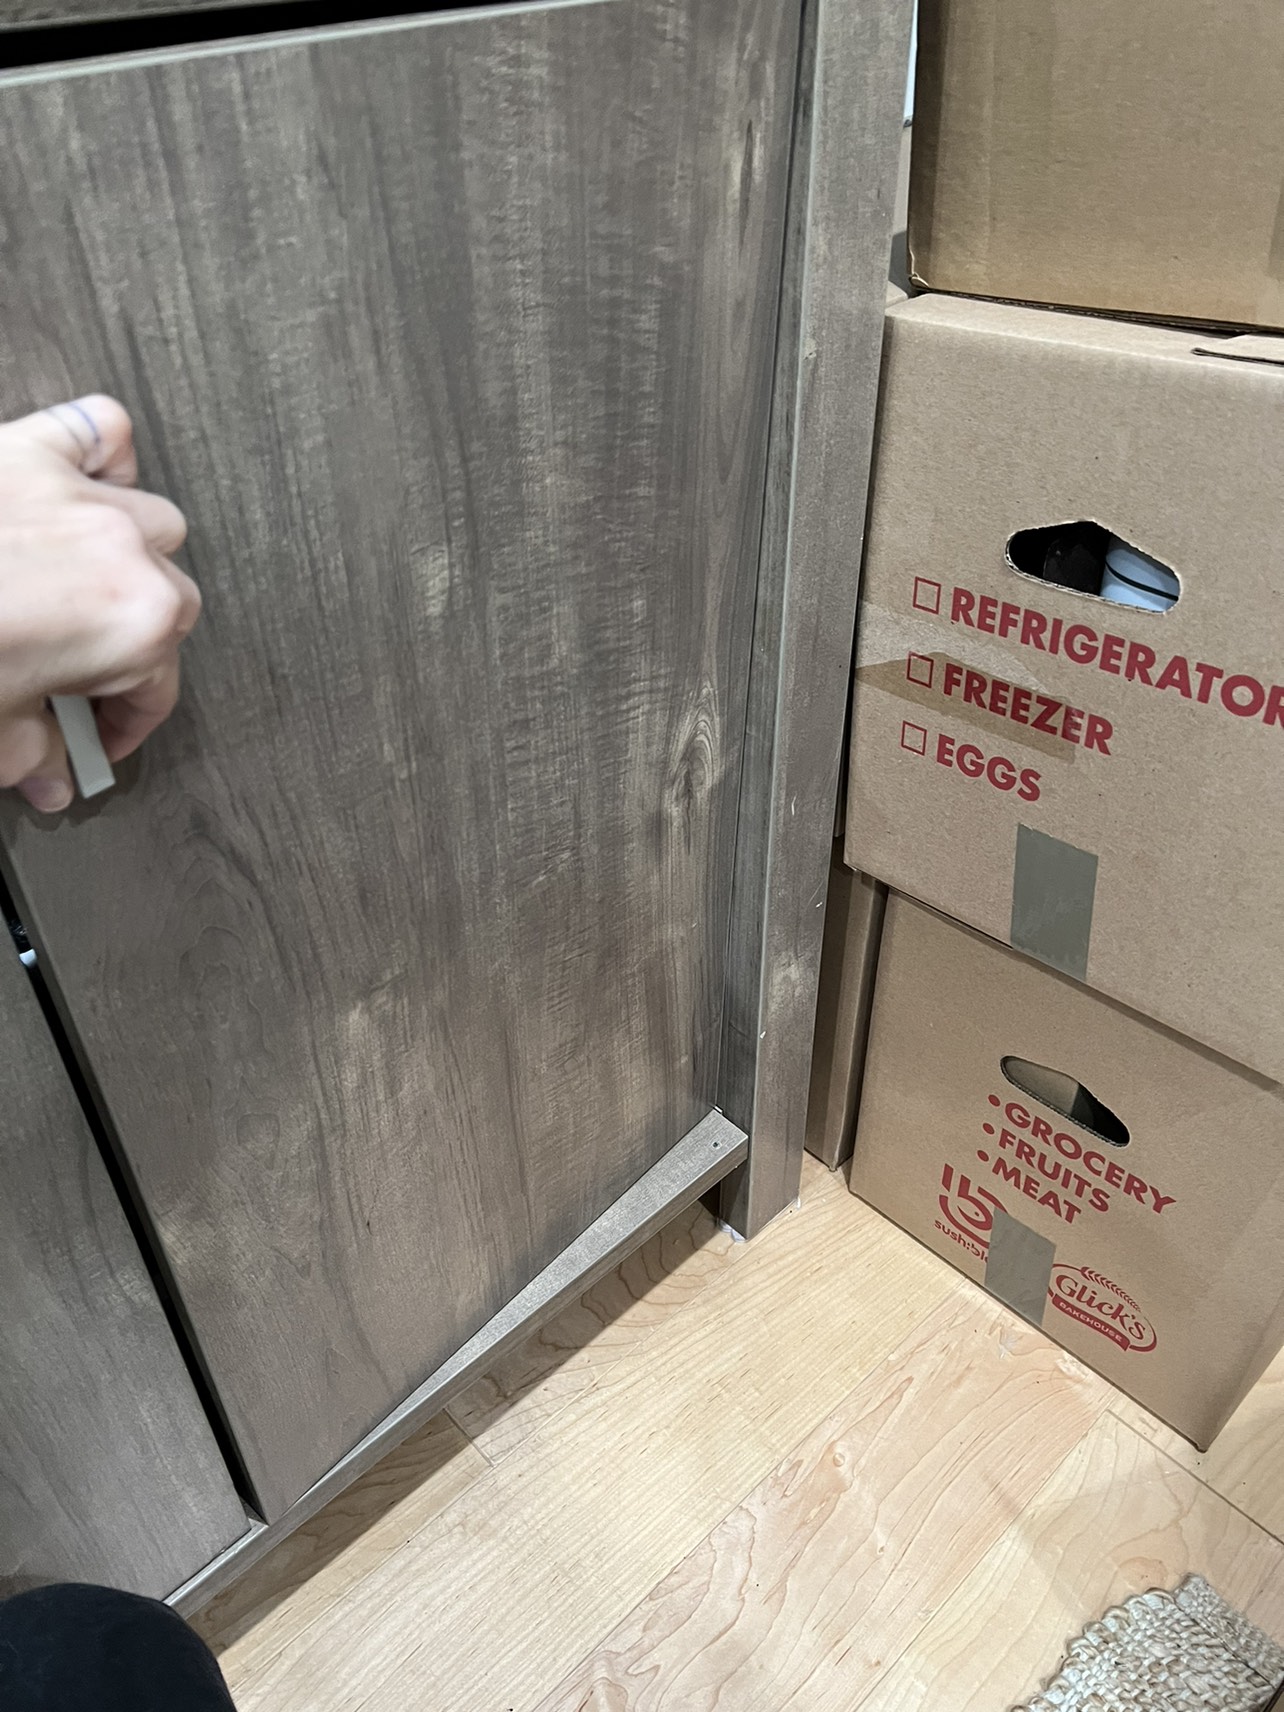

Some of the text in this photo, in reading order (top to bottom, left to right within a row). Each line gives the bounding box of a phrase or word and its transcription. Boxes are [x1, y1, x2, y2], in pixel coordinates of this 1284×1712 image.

[950, 587, 1284, 730] REFRIGERATOR
[942, 663, 1114, 756] FREEZER
[936, 734, 1042, 802] EGGS
[992, 1157, 1081, 1224] MEAT
[999, 1128, 1109, 1212] FRUITS
[1005, 1102, 1176, 1214] GROCERY
[1055, 1274, 1146, 1341] Glick's
[1059, 1301, 1123, 1343] BAKEHOUSE
